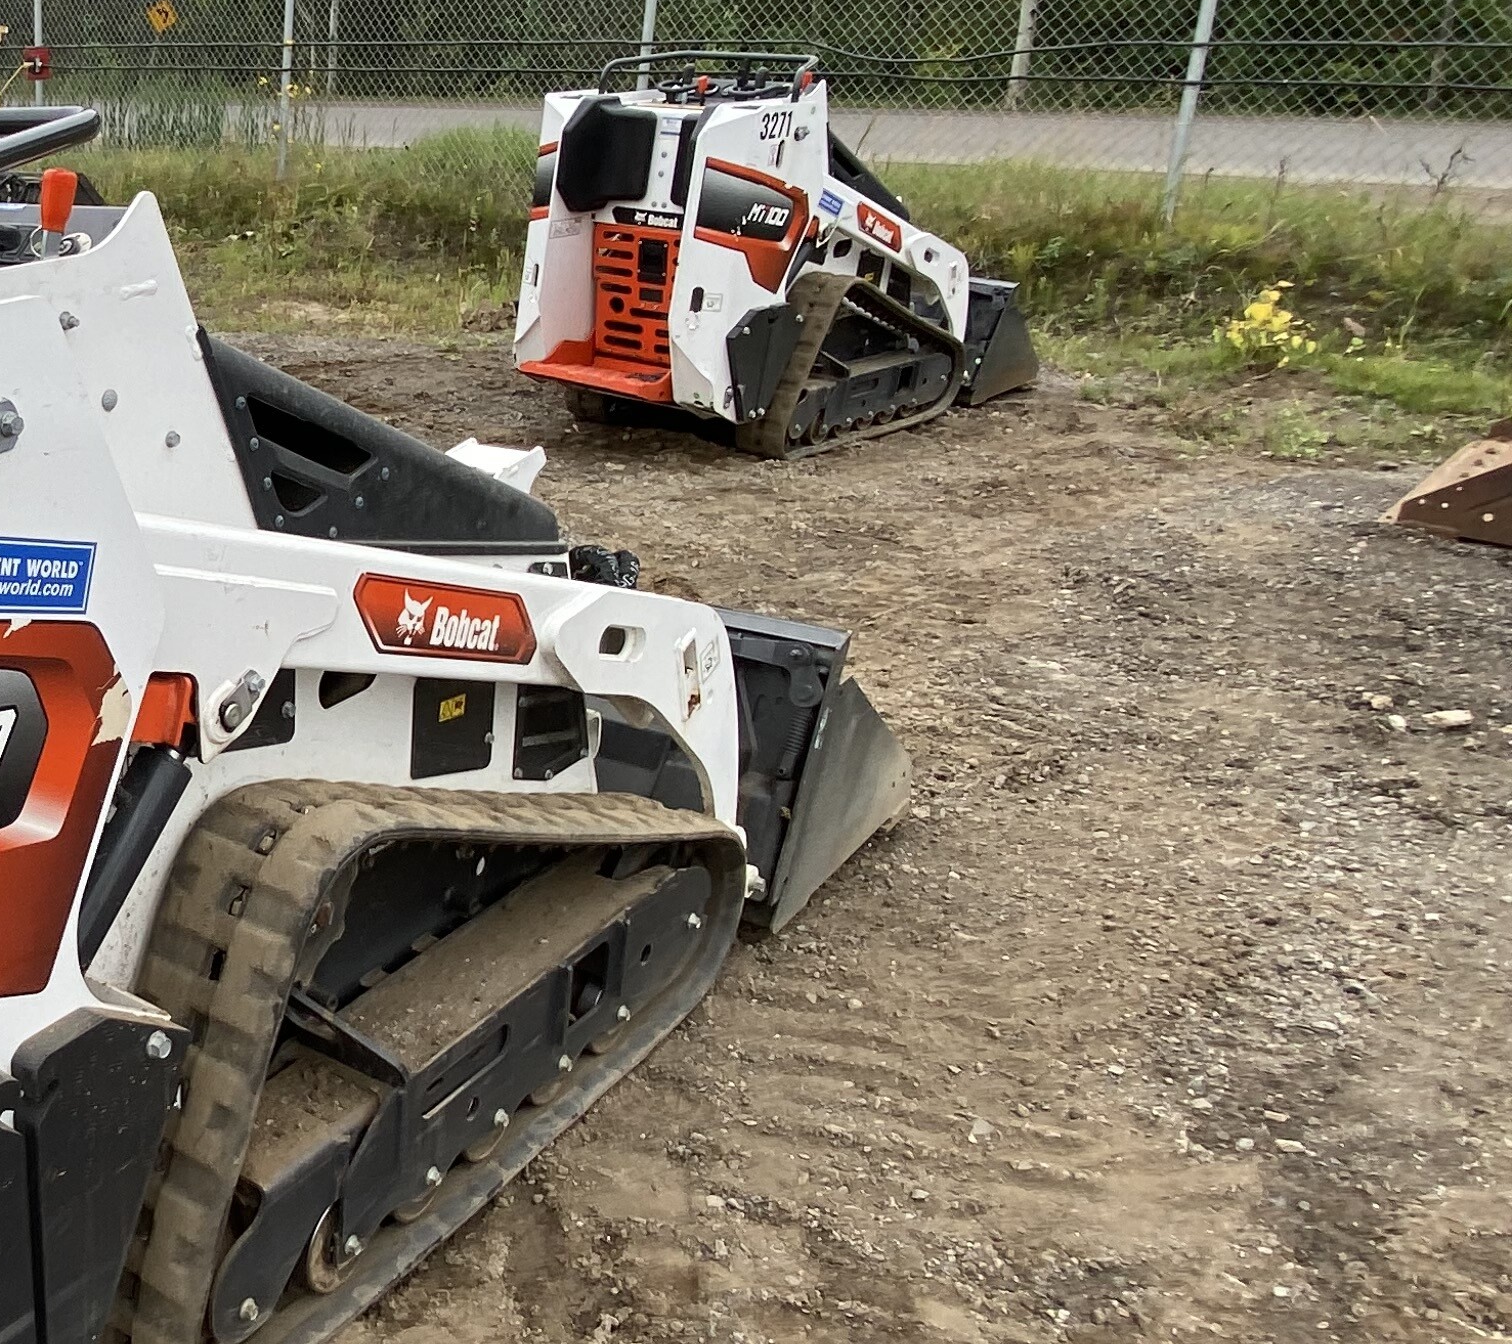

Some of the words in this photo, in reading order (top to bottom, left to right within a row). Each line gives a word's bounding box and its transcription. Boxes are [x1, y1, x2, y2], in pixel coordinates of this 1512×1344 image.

[760, 111, 793, 140] 3271
[647, 213, 678, 229] Bobcat
[429, 606, 500, 651] Bobcat
